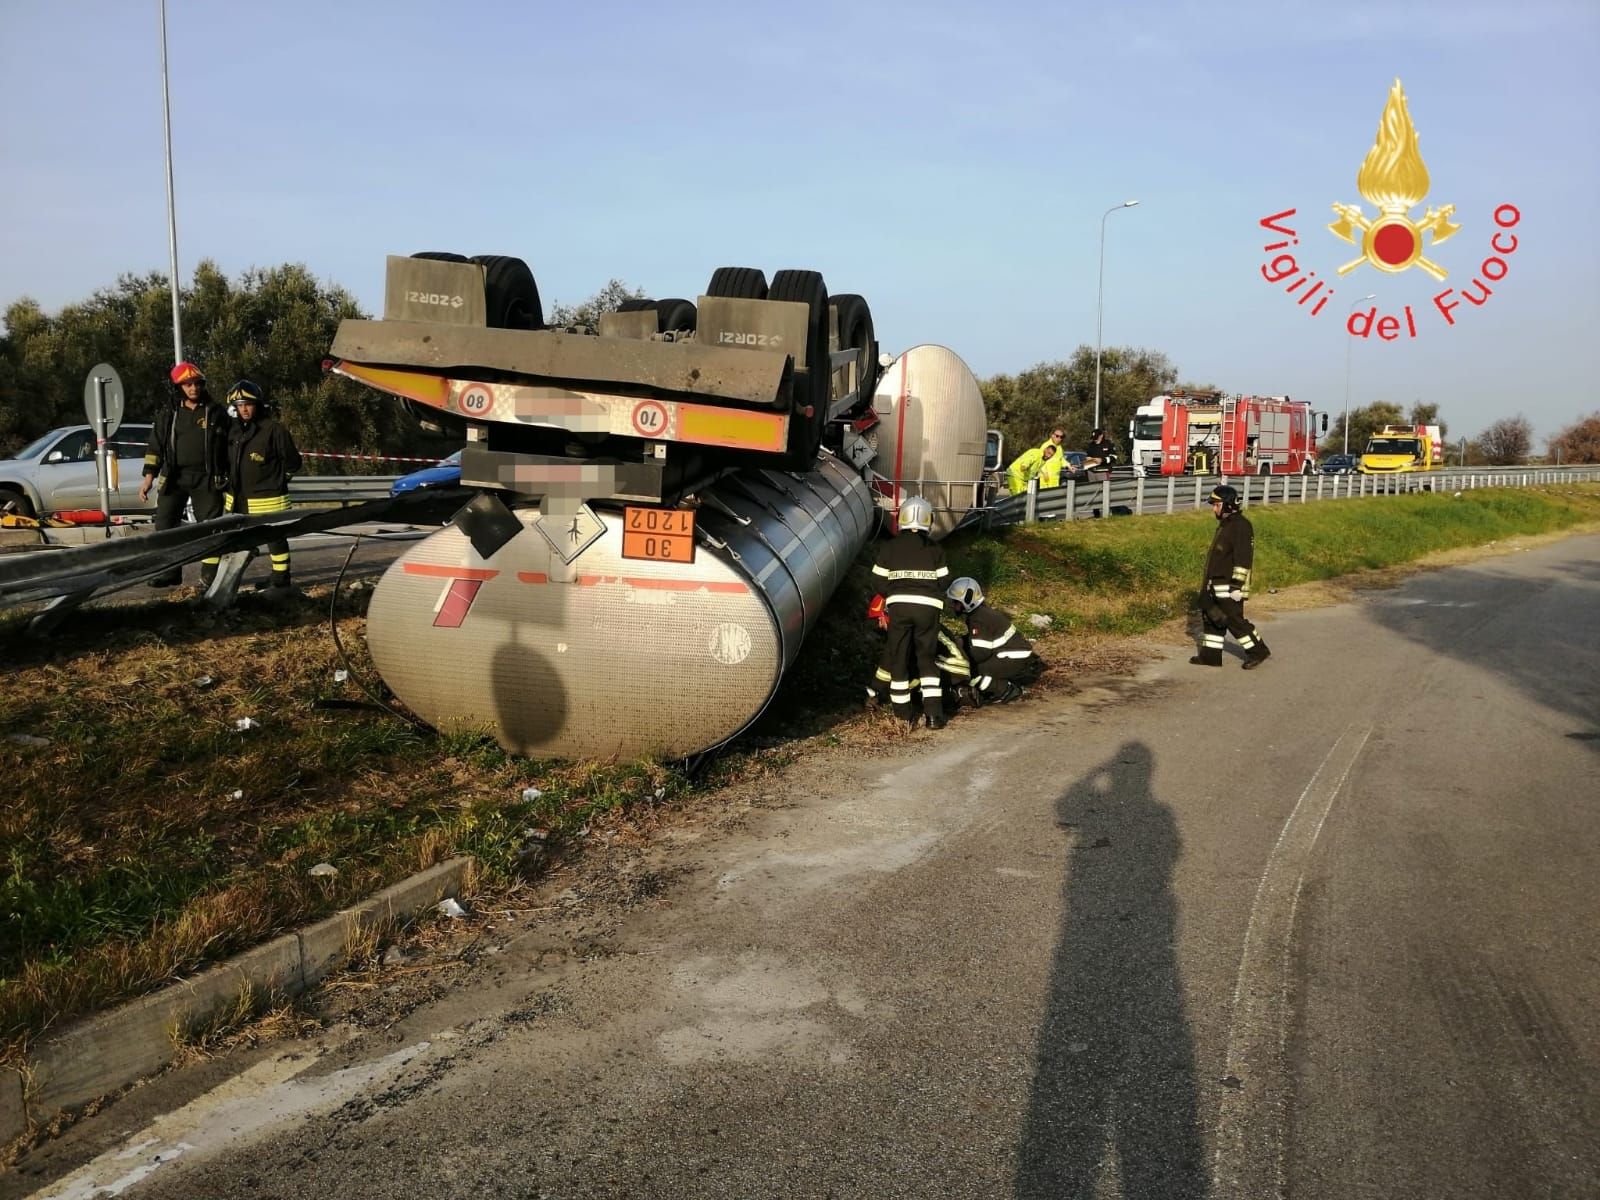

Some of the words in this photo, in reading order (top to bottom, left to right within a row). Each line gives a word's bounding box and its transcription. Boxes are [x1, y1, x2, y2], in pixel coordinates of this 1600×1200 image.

[404, 289, 450, 307] ZORZI
[718, 331, 769, 346] ZORZI
[466, 394, 485, 409] 80
[640, 410, 657, 427] 70
[631, 509, 689, 532] 1202
[645, 537, 672, 558] 30
